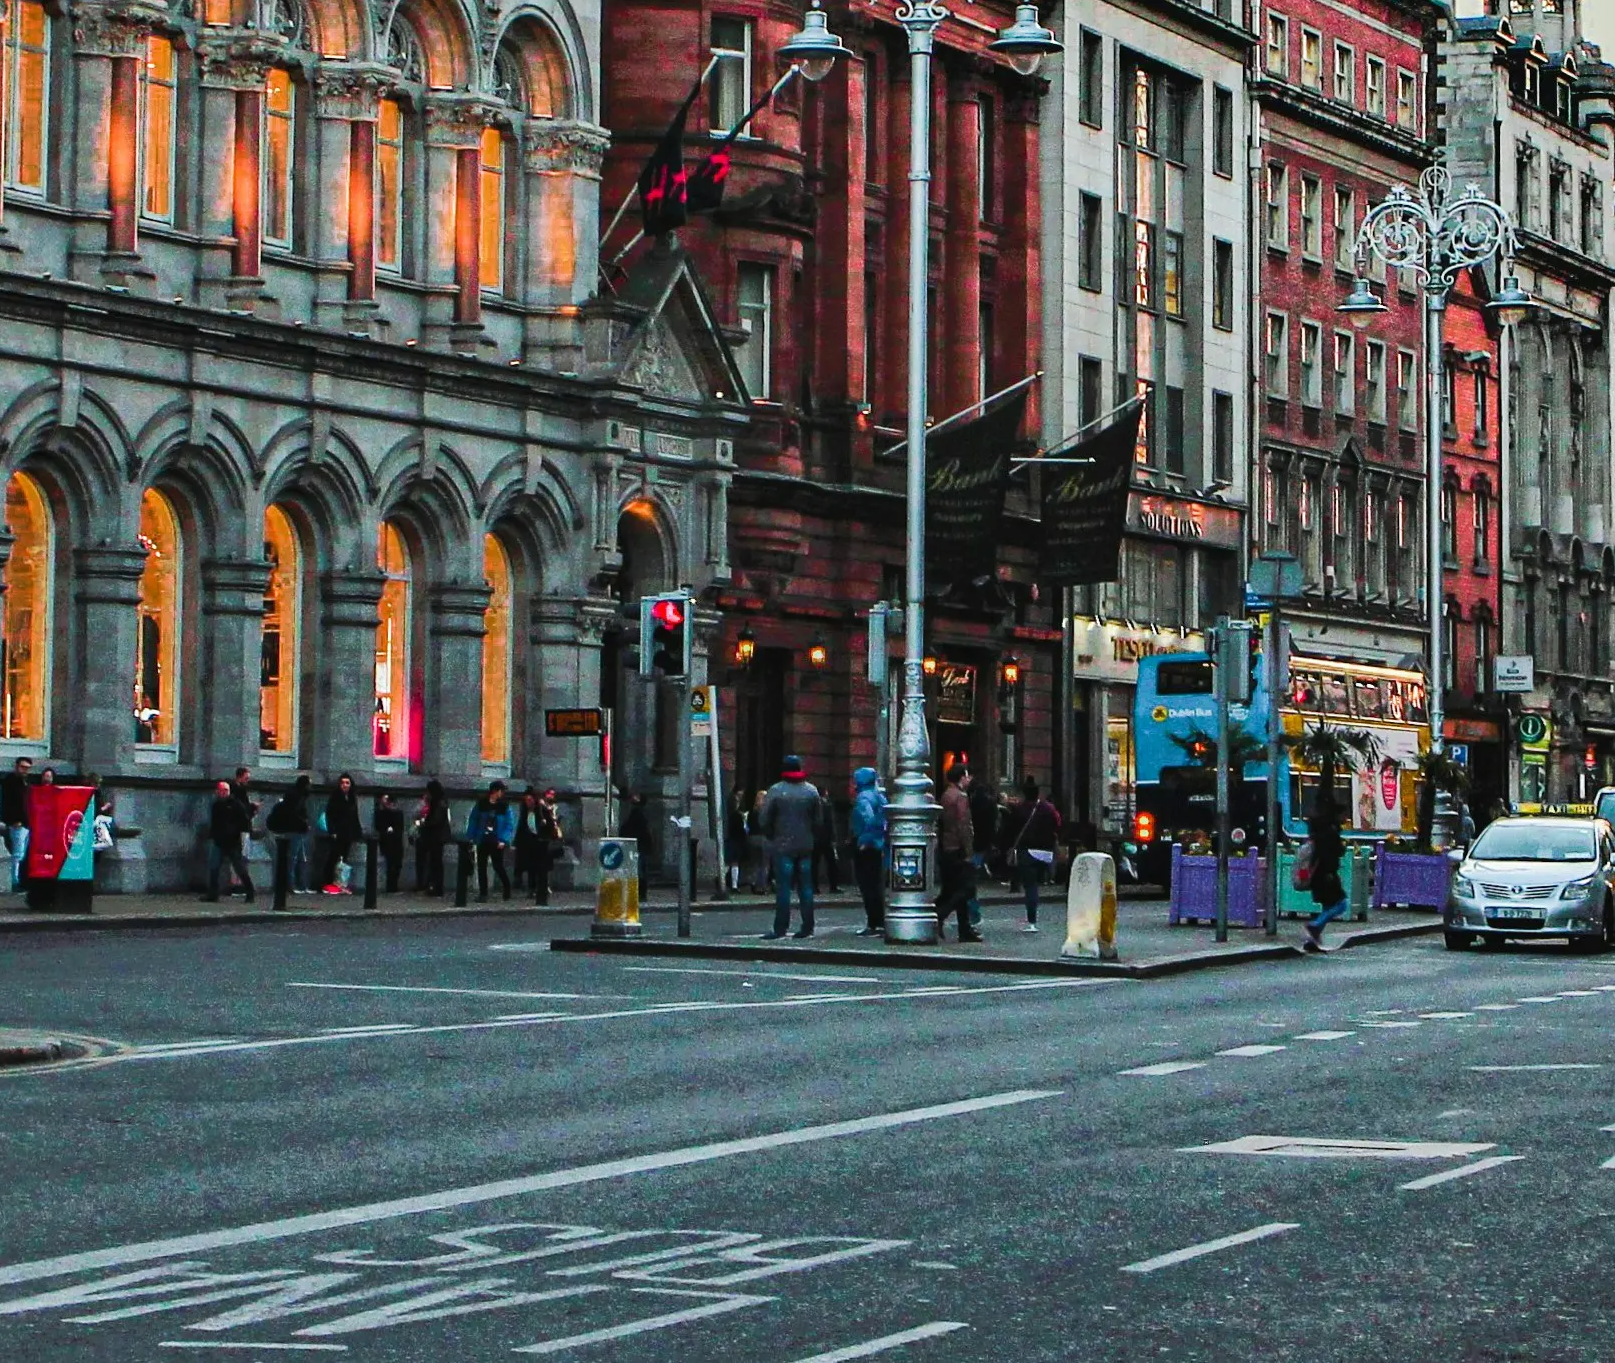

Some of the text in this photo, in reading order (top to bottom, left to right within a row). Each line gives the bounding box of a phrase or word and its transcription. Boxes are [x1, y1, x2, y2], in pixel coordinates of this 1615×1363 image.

[1142, 511, 1203, 537] SOLUTIONS
[1168, 708, 1213, 718] Dublin Bus
[312, 1223, 914, 1286] BUS
